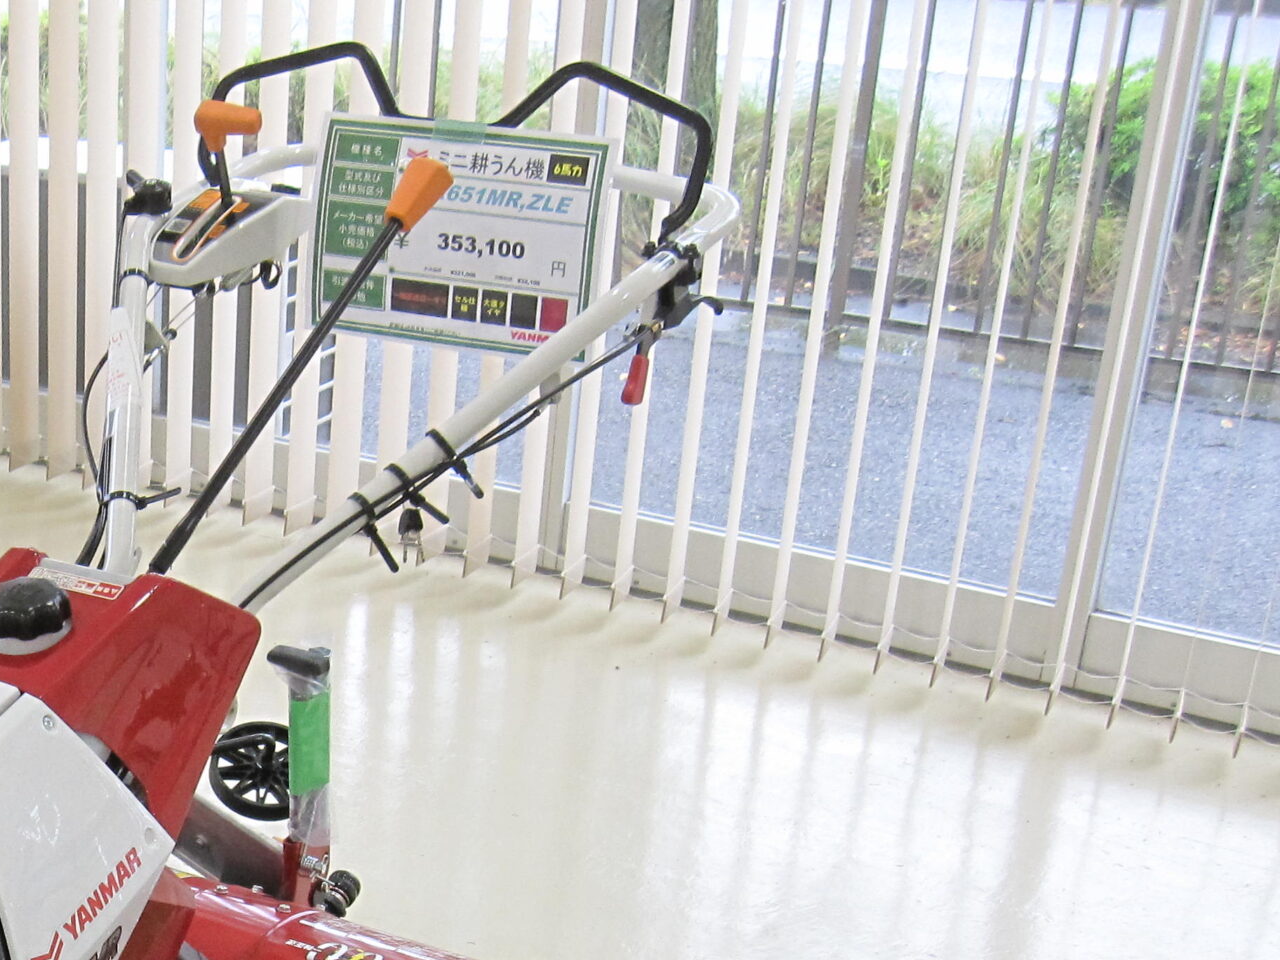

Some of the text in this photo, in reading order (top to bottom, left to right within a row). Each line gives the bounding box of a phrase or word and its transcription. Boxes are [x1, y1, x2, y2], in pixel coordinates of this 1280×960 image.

[439, 151, 545, 180] ミニ耕うん機
[440, 185, 574, 214] 651MR,ZLE
[437, 232, 526, 259] 353,100
[550, 260, 567, 278] 円
[62, 846, 142, 941] YANMAR
